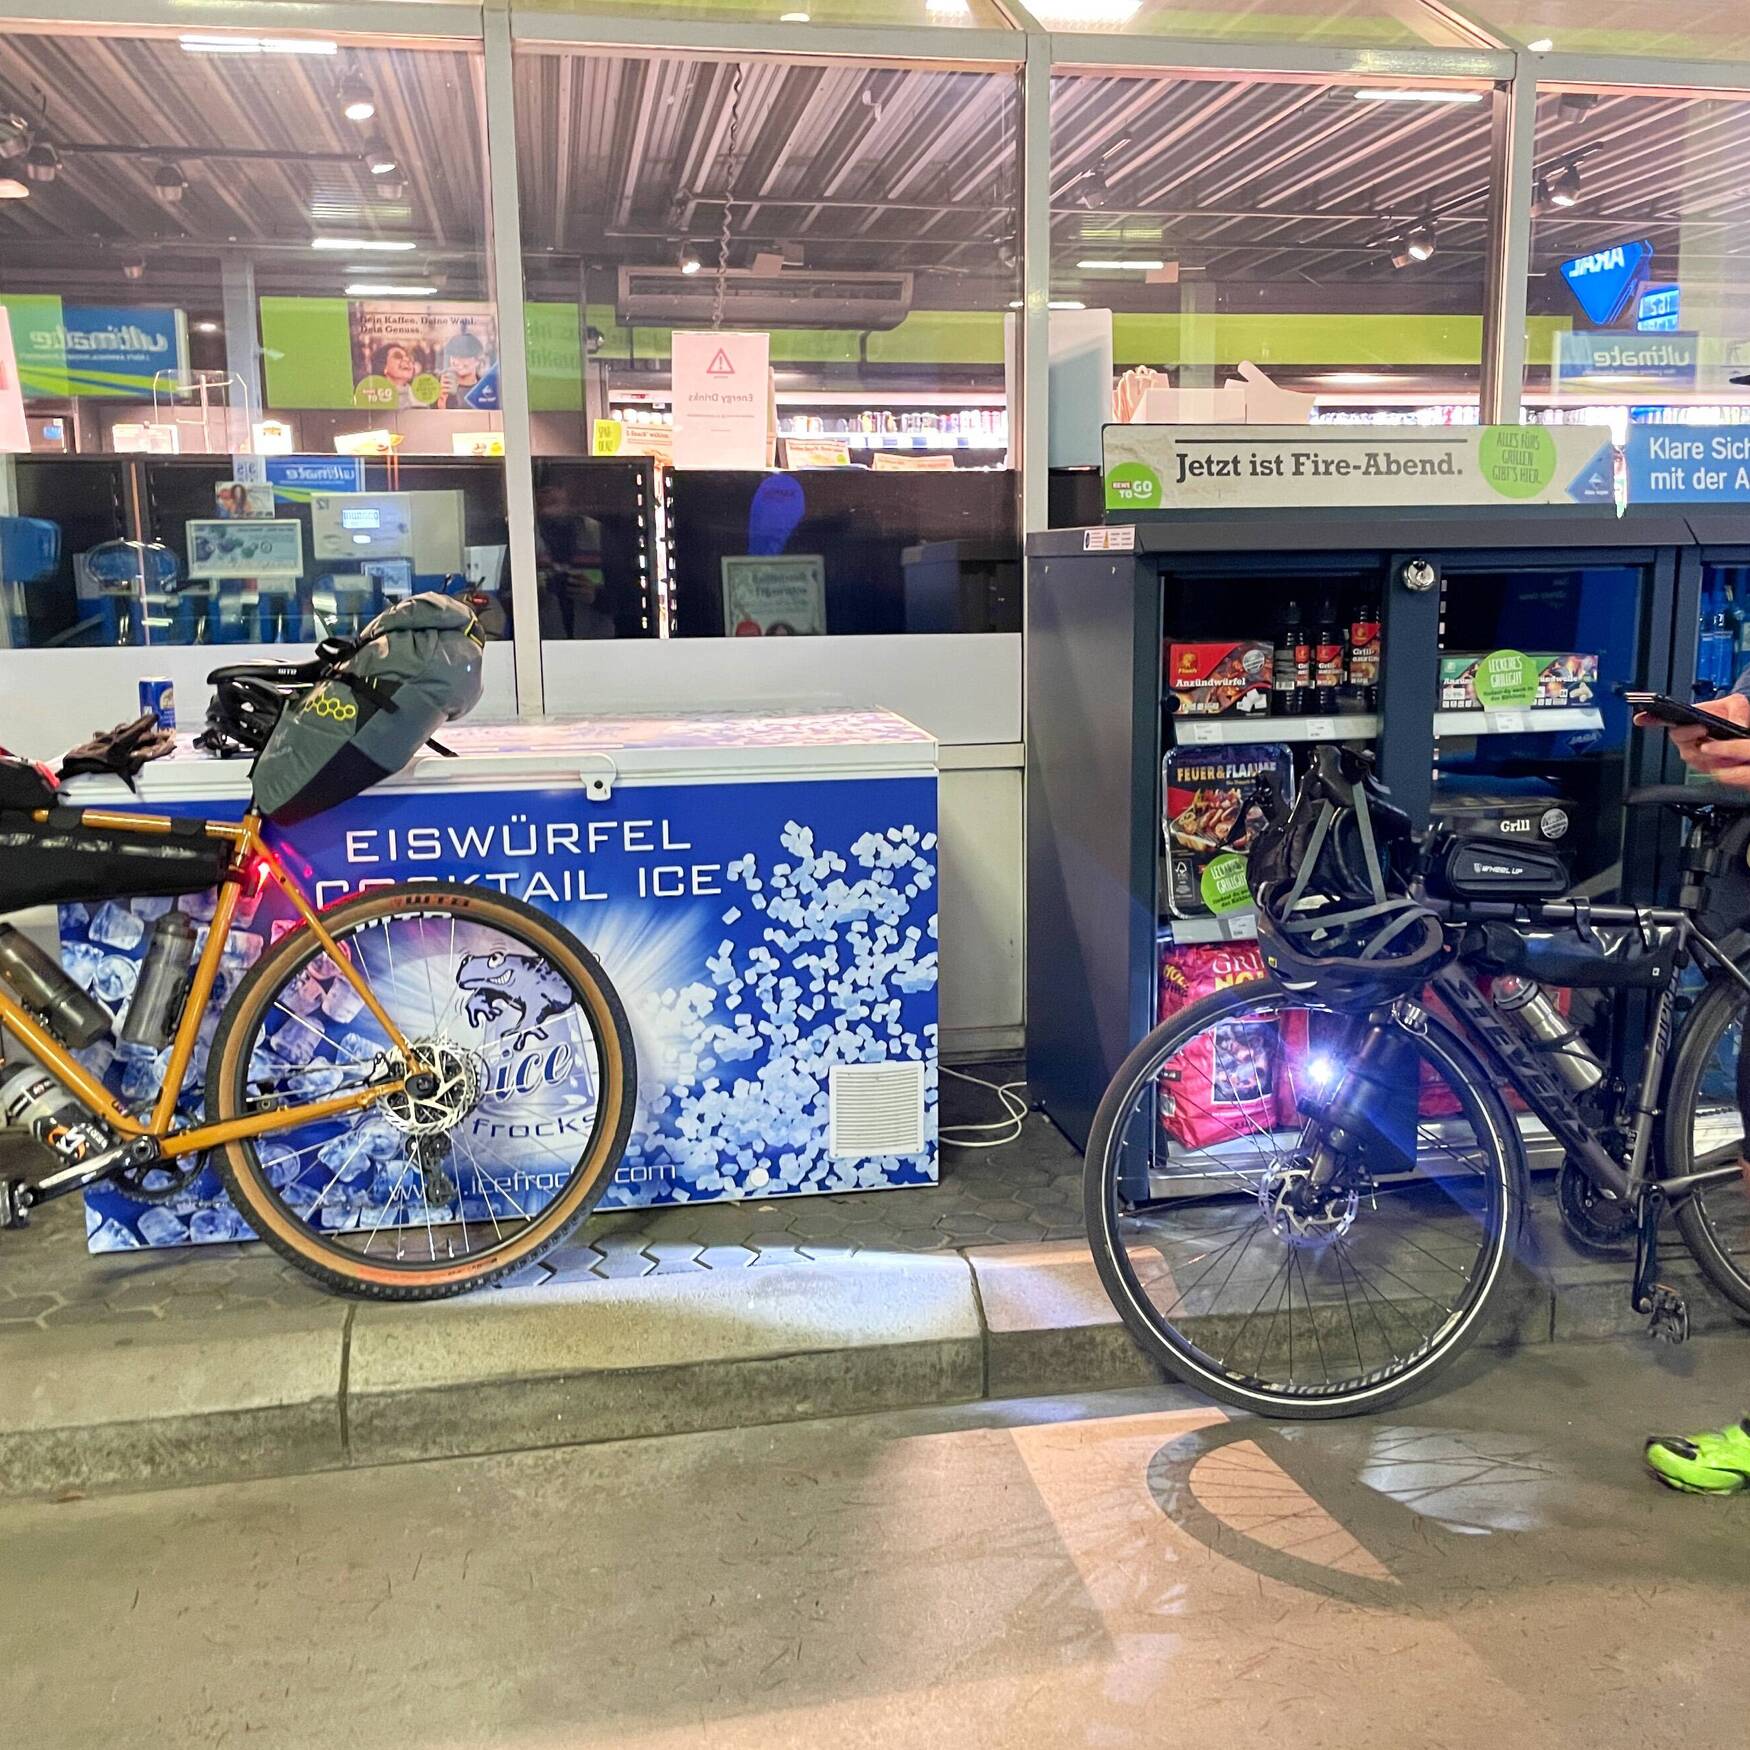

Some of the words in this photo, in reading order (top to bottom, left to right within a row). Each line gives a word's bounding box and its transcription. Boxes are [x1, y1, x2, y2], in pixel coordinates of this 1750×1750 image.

[360, 315, 383, 325] Dein
[385, 316, 418, 325] Kaffee.
[360, 326, 383, 335] Dein
[385, 325, 422, 335] Genuss.
[1649, 436, 1704, 460] Klare
[1176, 453, 1242, 483] Jetzt
[1249, 452, 1285, 476] ist
[1291, 452, 1464, 476] Fire-Abend.
[1650, 466, 1686, 490] mit
[1692, 466, 1728, 490] der
[1734, 466, 1750, 490] A
[1119, 489, 1133, 499] TO
[1133, 480, 1153, 492] GO
[1175, 678, 1246, 689] Anzündwürfel
[1501, 819, 1531, 833] Grill
[345, 813, 693, 864] EISWÜRFEL
[1482, 864, 1511, 874] WHEEL
[1511, 867, 1524, 875] UP
[315, 868, 609, 910] CTAIL
[639, 863, 725, 898] ICE
[494, 1041, 573, 1103] ice
[1443, 976, 1589, 1144] STEVENS
[472, 1111, 597, 1138] frocks
